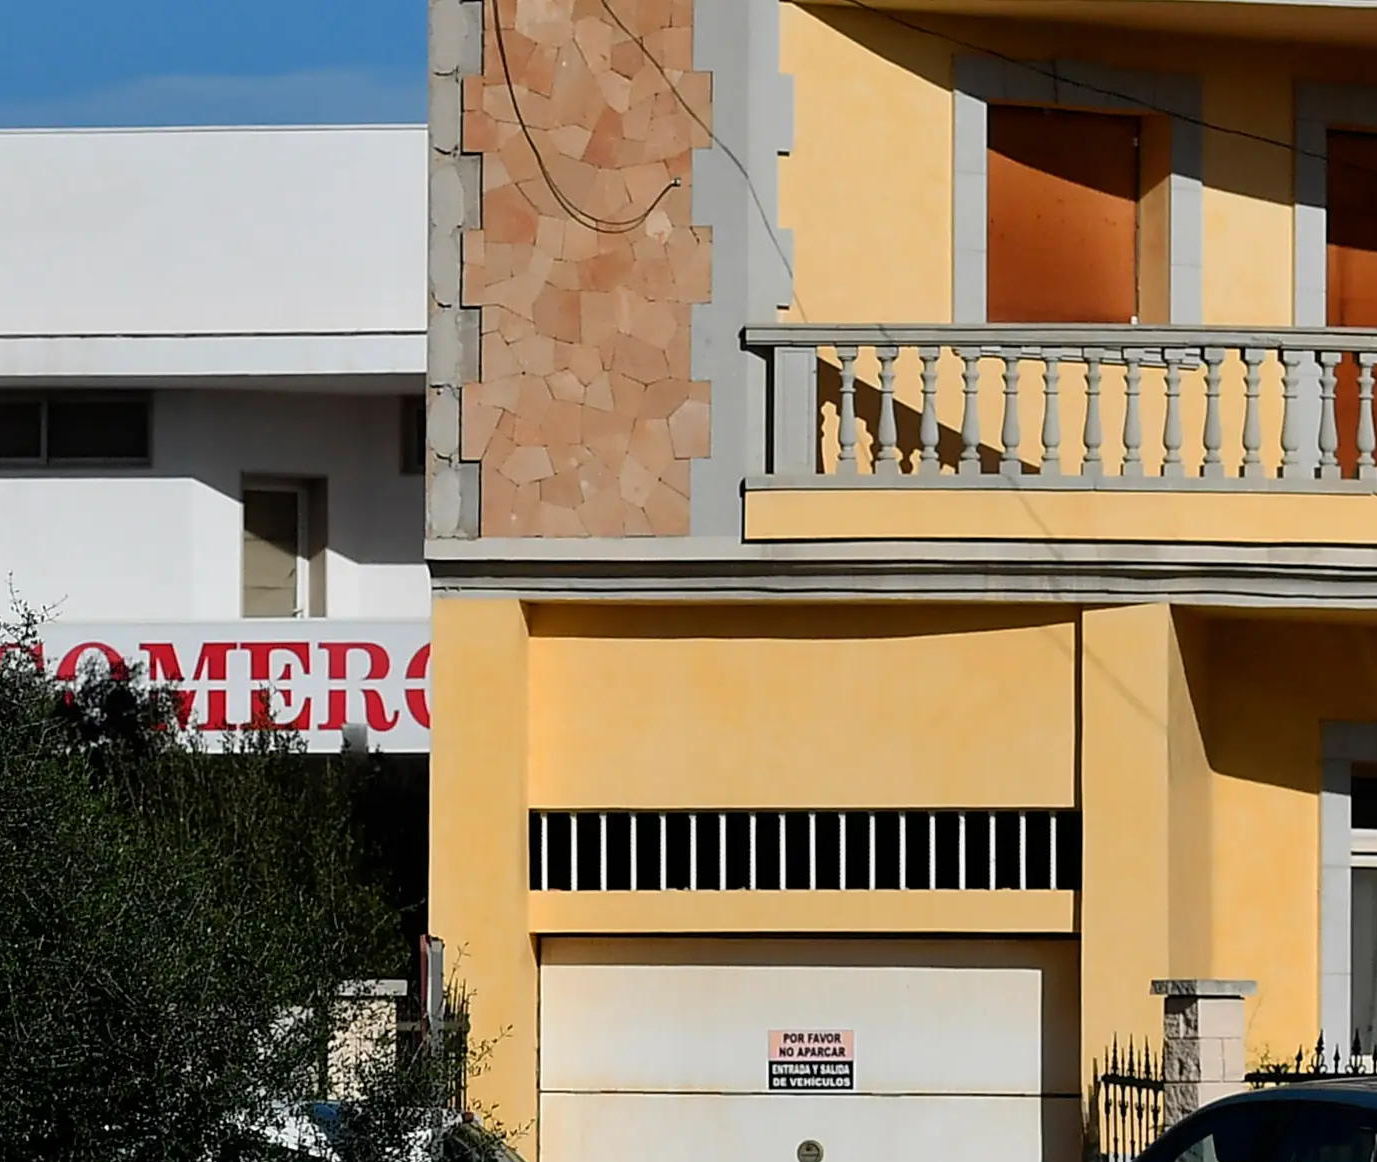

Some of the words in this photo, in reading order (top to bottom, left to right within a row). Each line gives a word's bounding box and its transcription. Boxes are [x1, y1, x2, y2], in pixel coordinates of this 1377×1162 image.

[783, 1033, 805, 1044] POR
[807, 1033, 842, 1044] FAVOR
[779, 1047, 794, 1057] NO
[797, 1047, 846, 1057] APARCAR
[772, 1064, 811, 1075] ENTRADA
[812, 1064, 819, 1075] Y
[820, 1064, 850, 1075] SALIDA
[773, 1077, 787, 1087] DE
[789, 1075, 851, 1087] VEHÍCULOS
